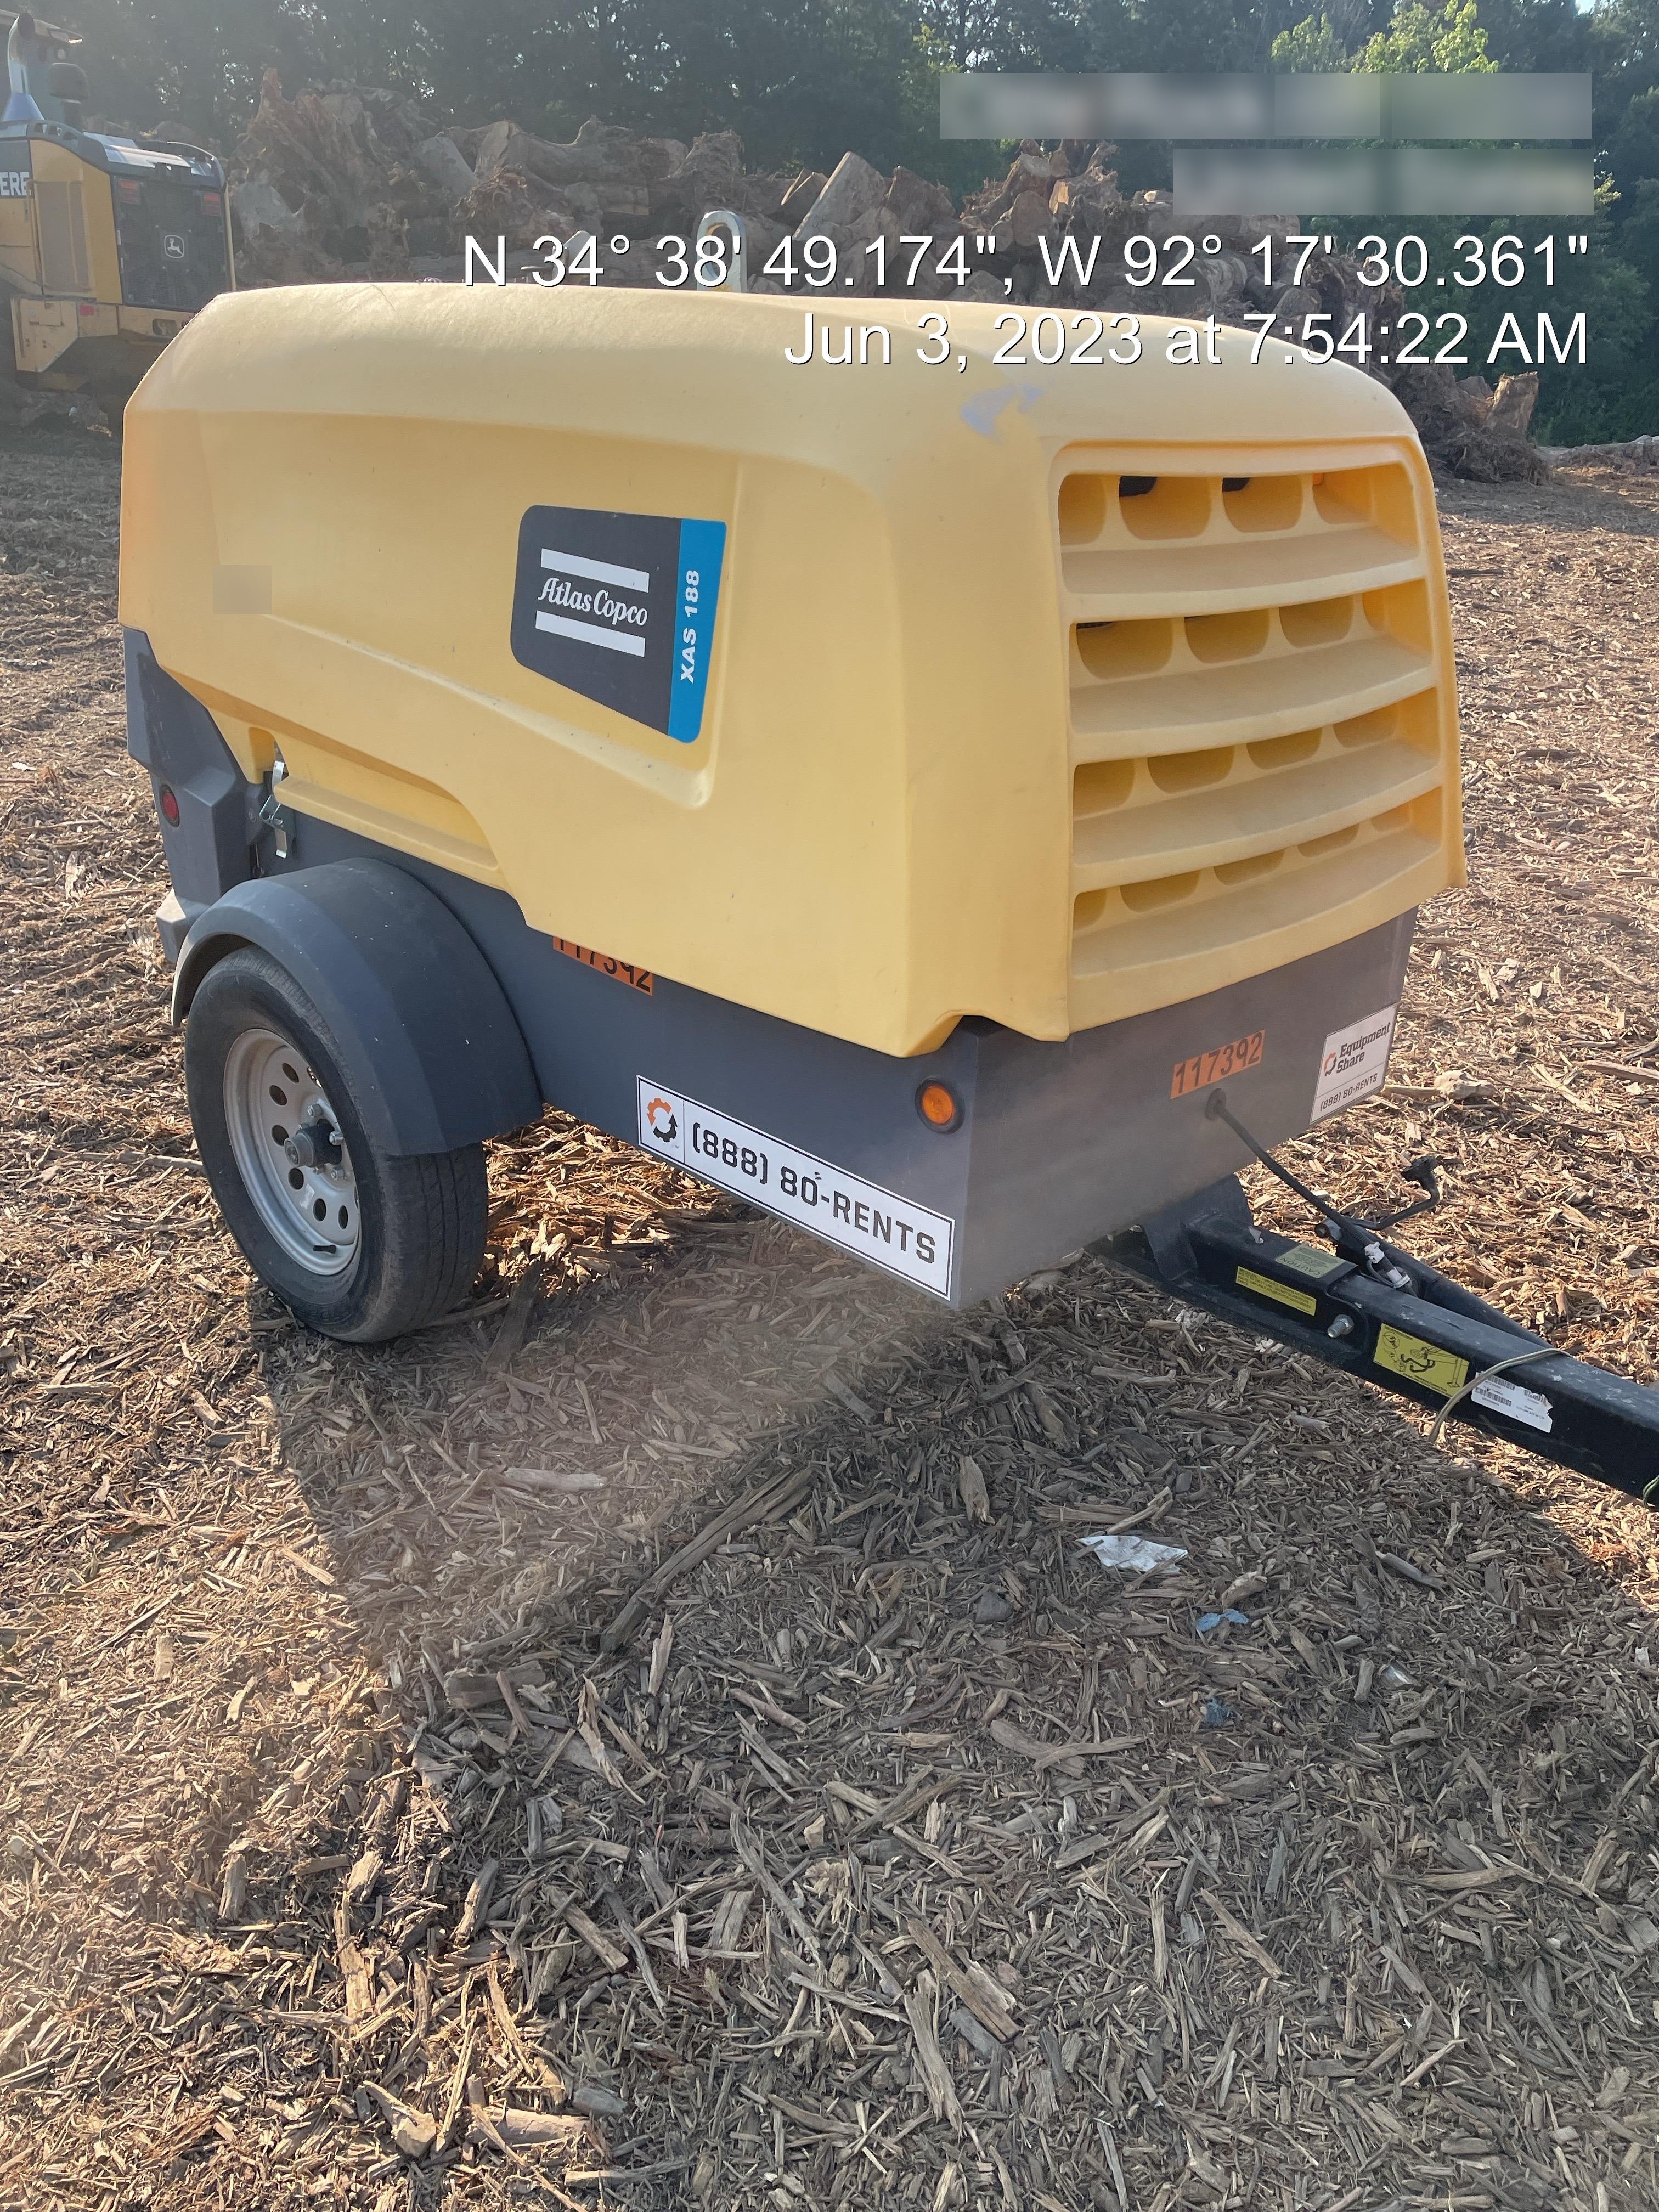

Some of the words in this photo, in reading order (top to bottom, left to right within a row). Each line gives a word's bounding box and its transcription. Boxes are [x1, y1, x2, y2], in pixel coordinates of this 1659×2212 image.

[685, 570, 700, 618] 188
[681, 628, 697, 684] XAS
[1339, 1022, 1391, 1058] Equipment
[1175, 1031, 1262, 1093] 117392
[1336, 1051, 1365, 1074] Share
[1320, 1092, 1341, 1111] (888)
[1342, 1073, 1378, 1099] 80-RENTS
[693, 1122, 768, 1185] (888)
[781, 1166, 935, 1264] 80-RENTS
[1280, 1257, 1321, 1276] CAUTION
